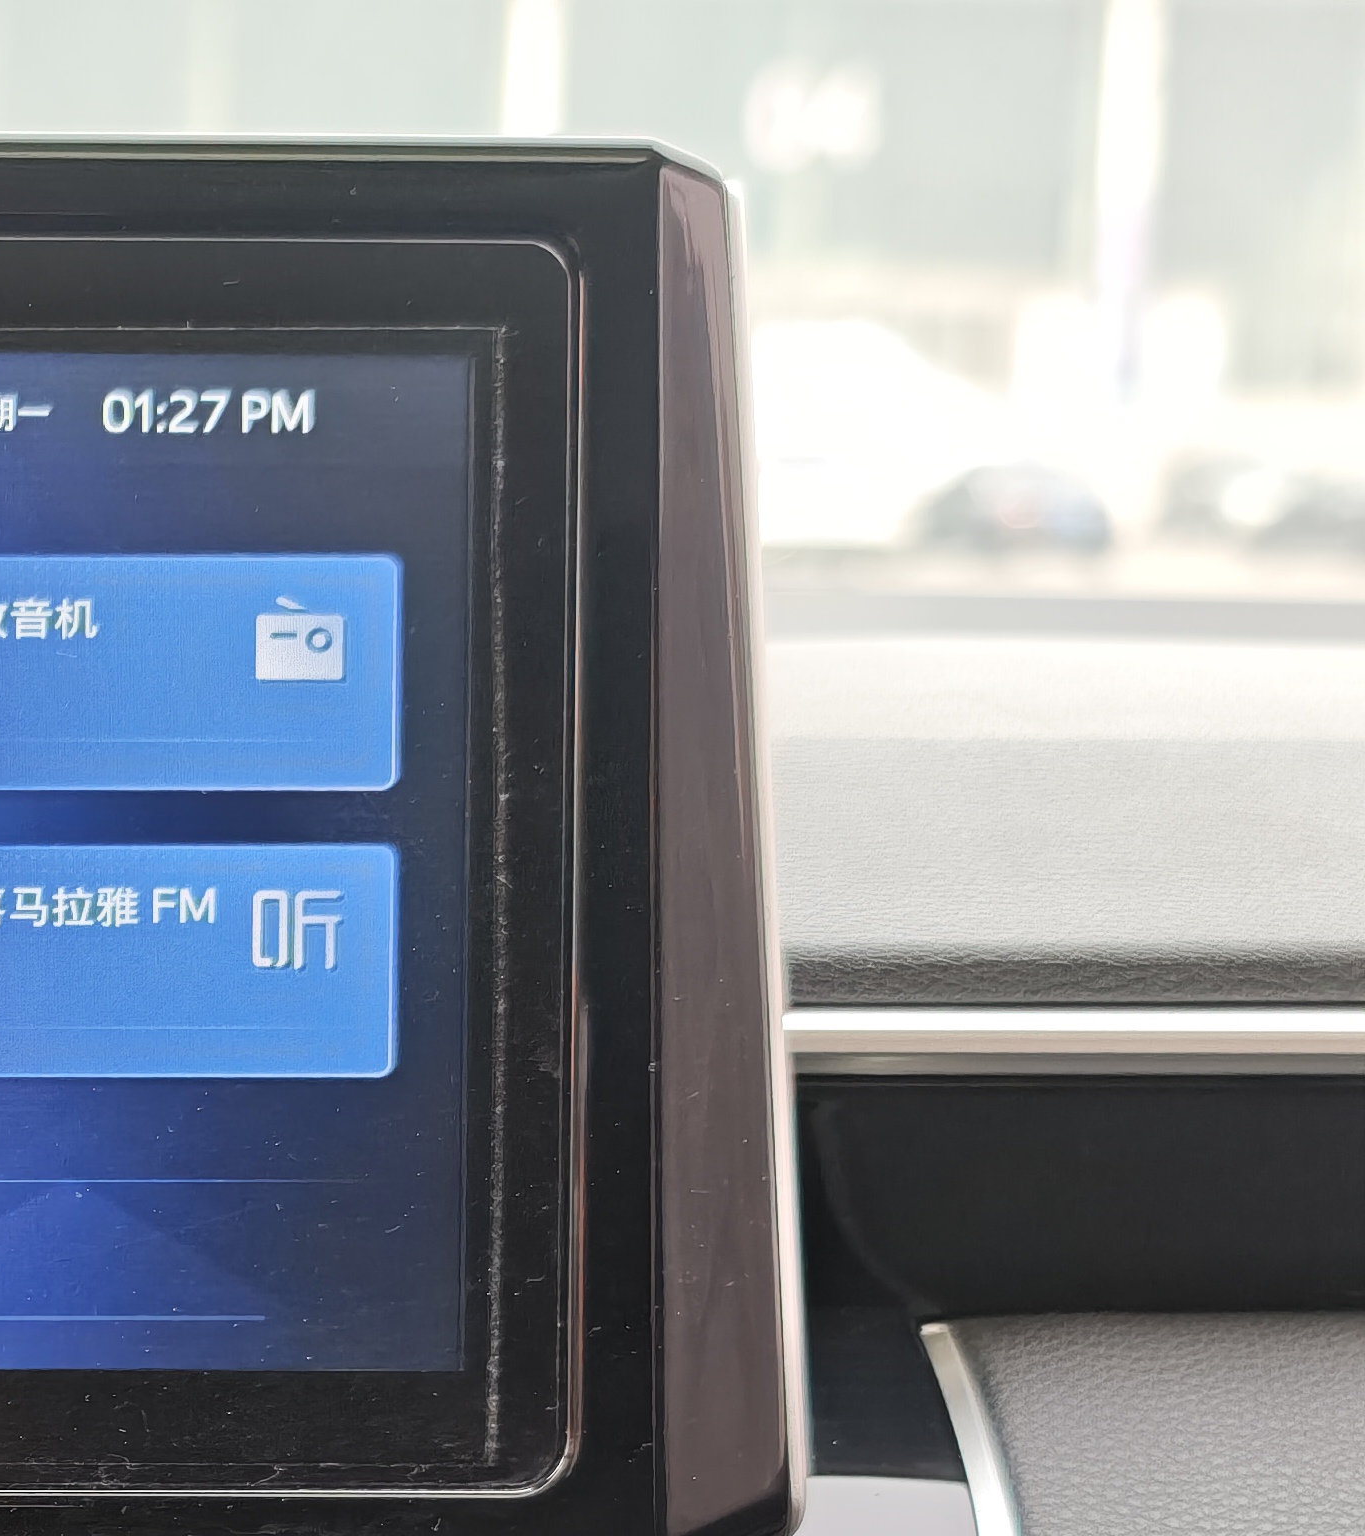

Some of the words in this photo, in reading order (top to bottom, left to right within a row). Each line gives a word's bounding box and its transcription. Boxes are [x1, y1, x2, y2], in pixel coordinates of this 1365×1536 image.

[101, 389, 228, 435] 01:27
[240, 389, 316, 434] PM
[152, 887, 218, 925] FM
